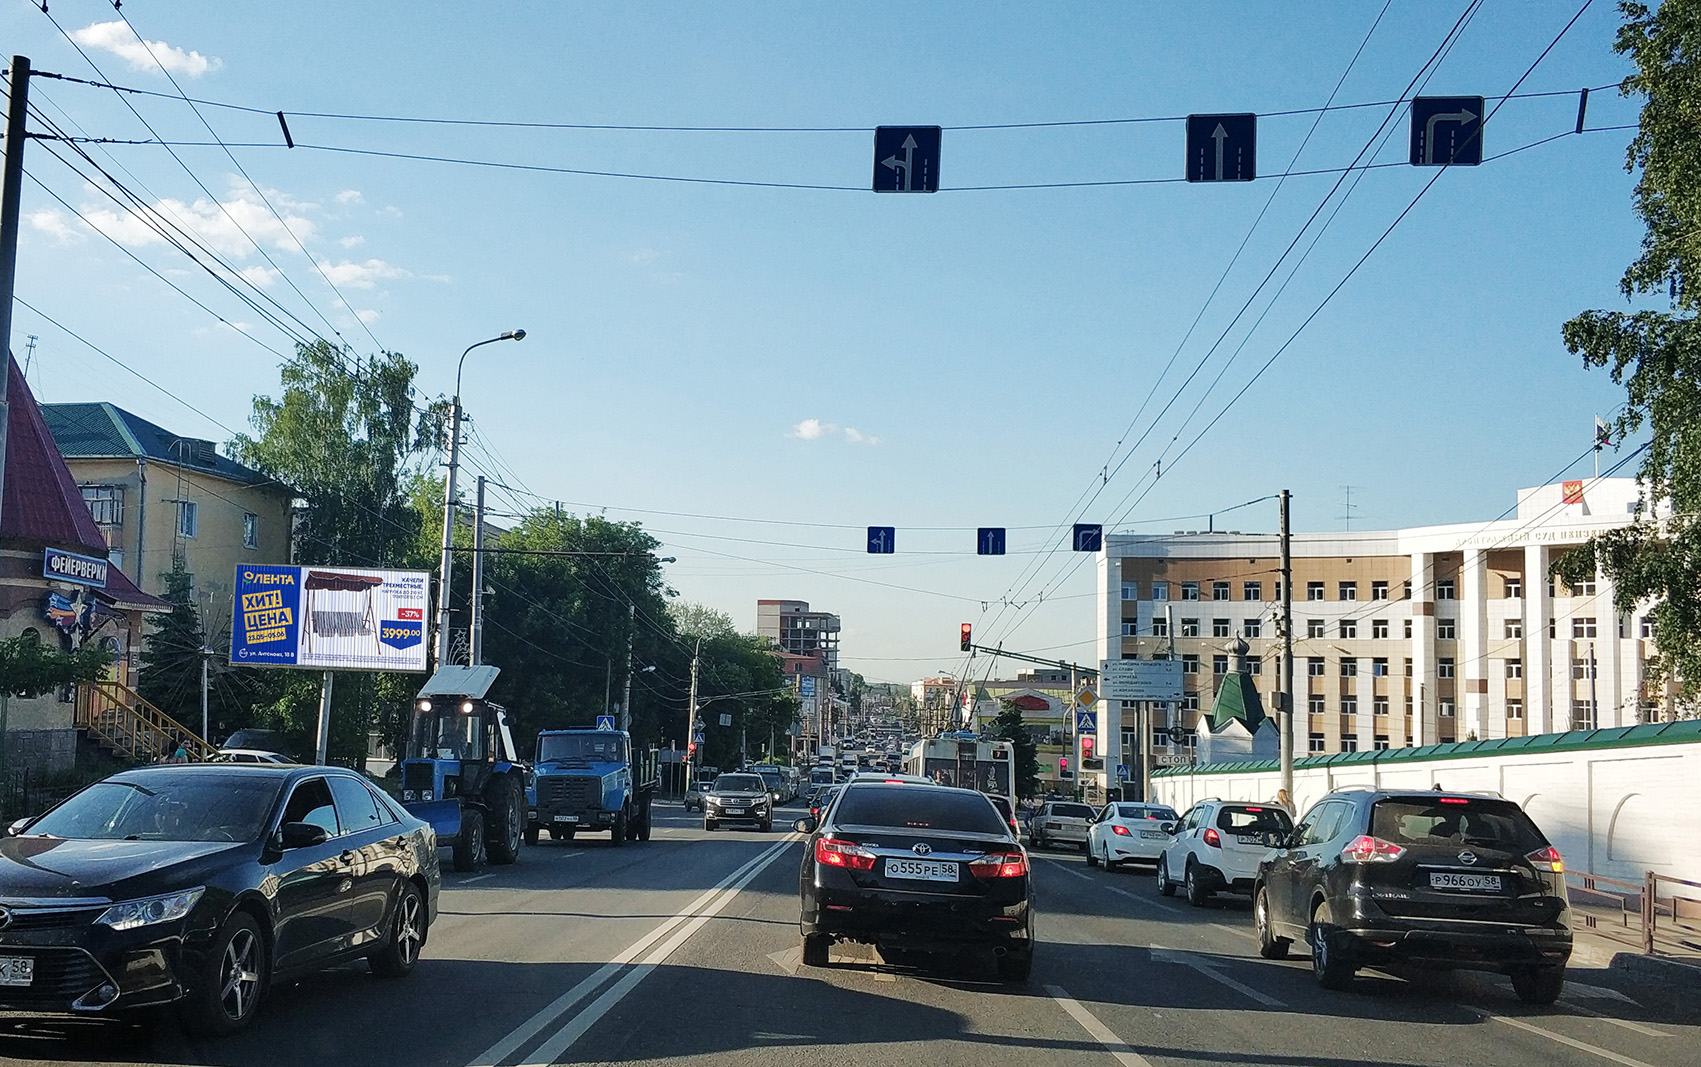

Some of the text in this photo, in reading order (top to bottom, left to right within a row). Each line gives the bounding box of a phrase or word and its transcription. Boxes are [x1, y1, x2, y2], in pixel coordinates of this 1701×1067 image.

[1535, 531, 1556, 541] СУД
[253, 573, 295, 585] ЛЕНТА
[245, 592, 280, 609] ХИТ!
[401, 610, 420, 618] -37%
[247, 611, 289, 629] ЦЕНА
[382, 628, 421, 639] 3999.00
[1161, 756, 1186, 764] СТОП
[941, 863, 954, 874] 58
[1484, 876, 1497, 885] 58
[12, 960, 27, 974] 58
